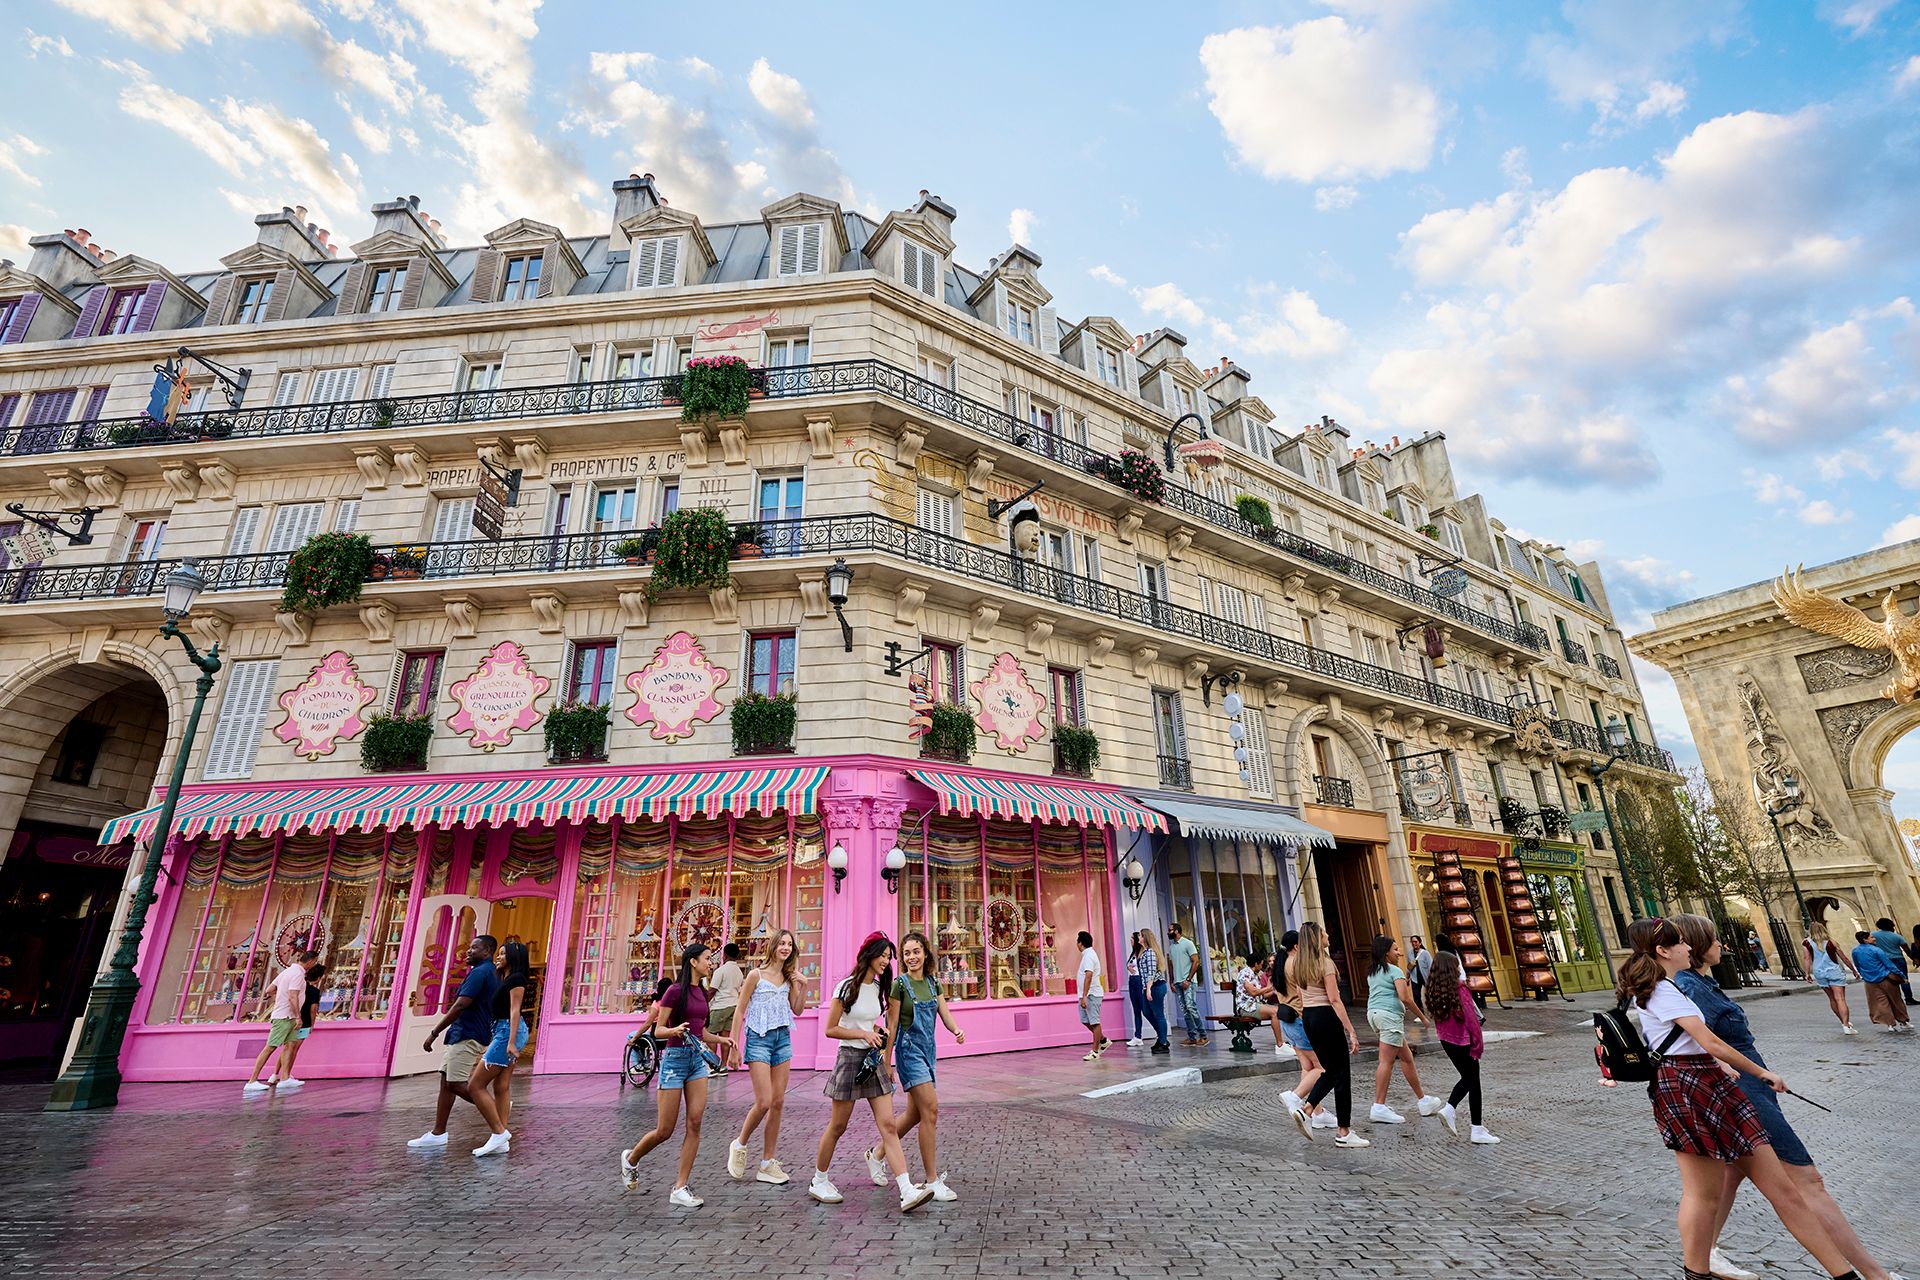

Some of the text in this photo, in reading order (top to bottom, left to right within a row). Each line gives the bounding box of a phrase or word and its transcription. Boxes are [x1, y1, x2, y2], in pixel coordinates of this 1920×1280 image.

[550, 456, 639, 478] PROPENTUS
[647, 455, 657, 471] &
[1053, 500, 1118, 534] VOLANTS
[24, 533, 45, 561] CLUB
[479, 680, 511, 691] CUISSES
[653, 672, 703, 685] BONBONS
[301, 691, 354, 705] FONDANTS
[470, 690, 527, 701] GRENOUILLES
[647, 690, 707, 704] CLASSIQUES
[997, 688, 1023, 700] CHOCO
[471, 700, 522, 712] EN CHOCOLAT
[988, 703, 1032, 719] GRENOUILLE
[298, 706, 351, 721] CHAUDRON
